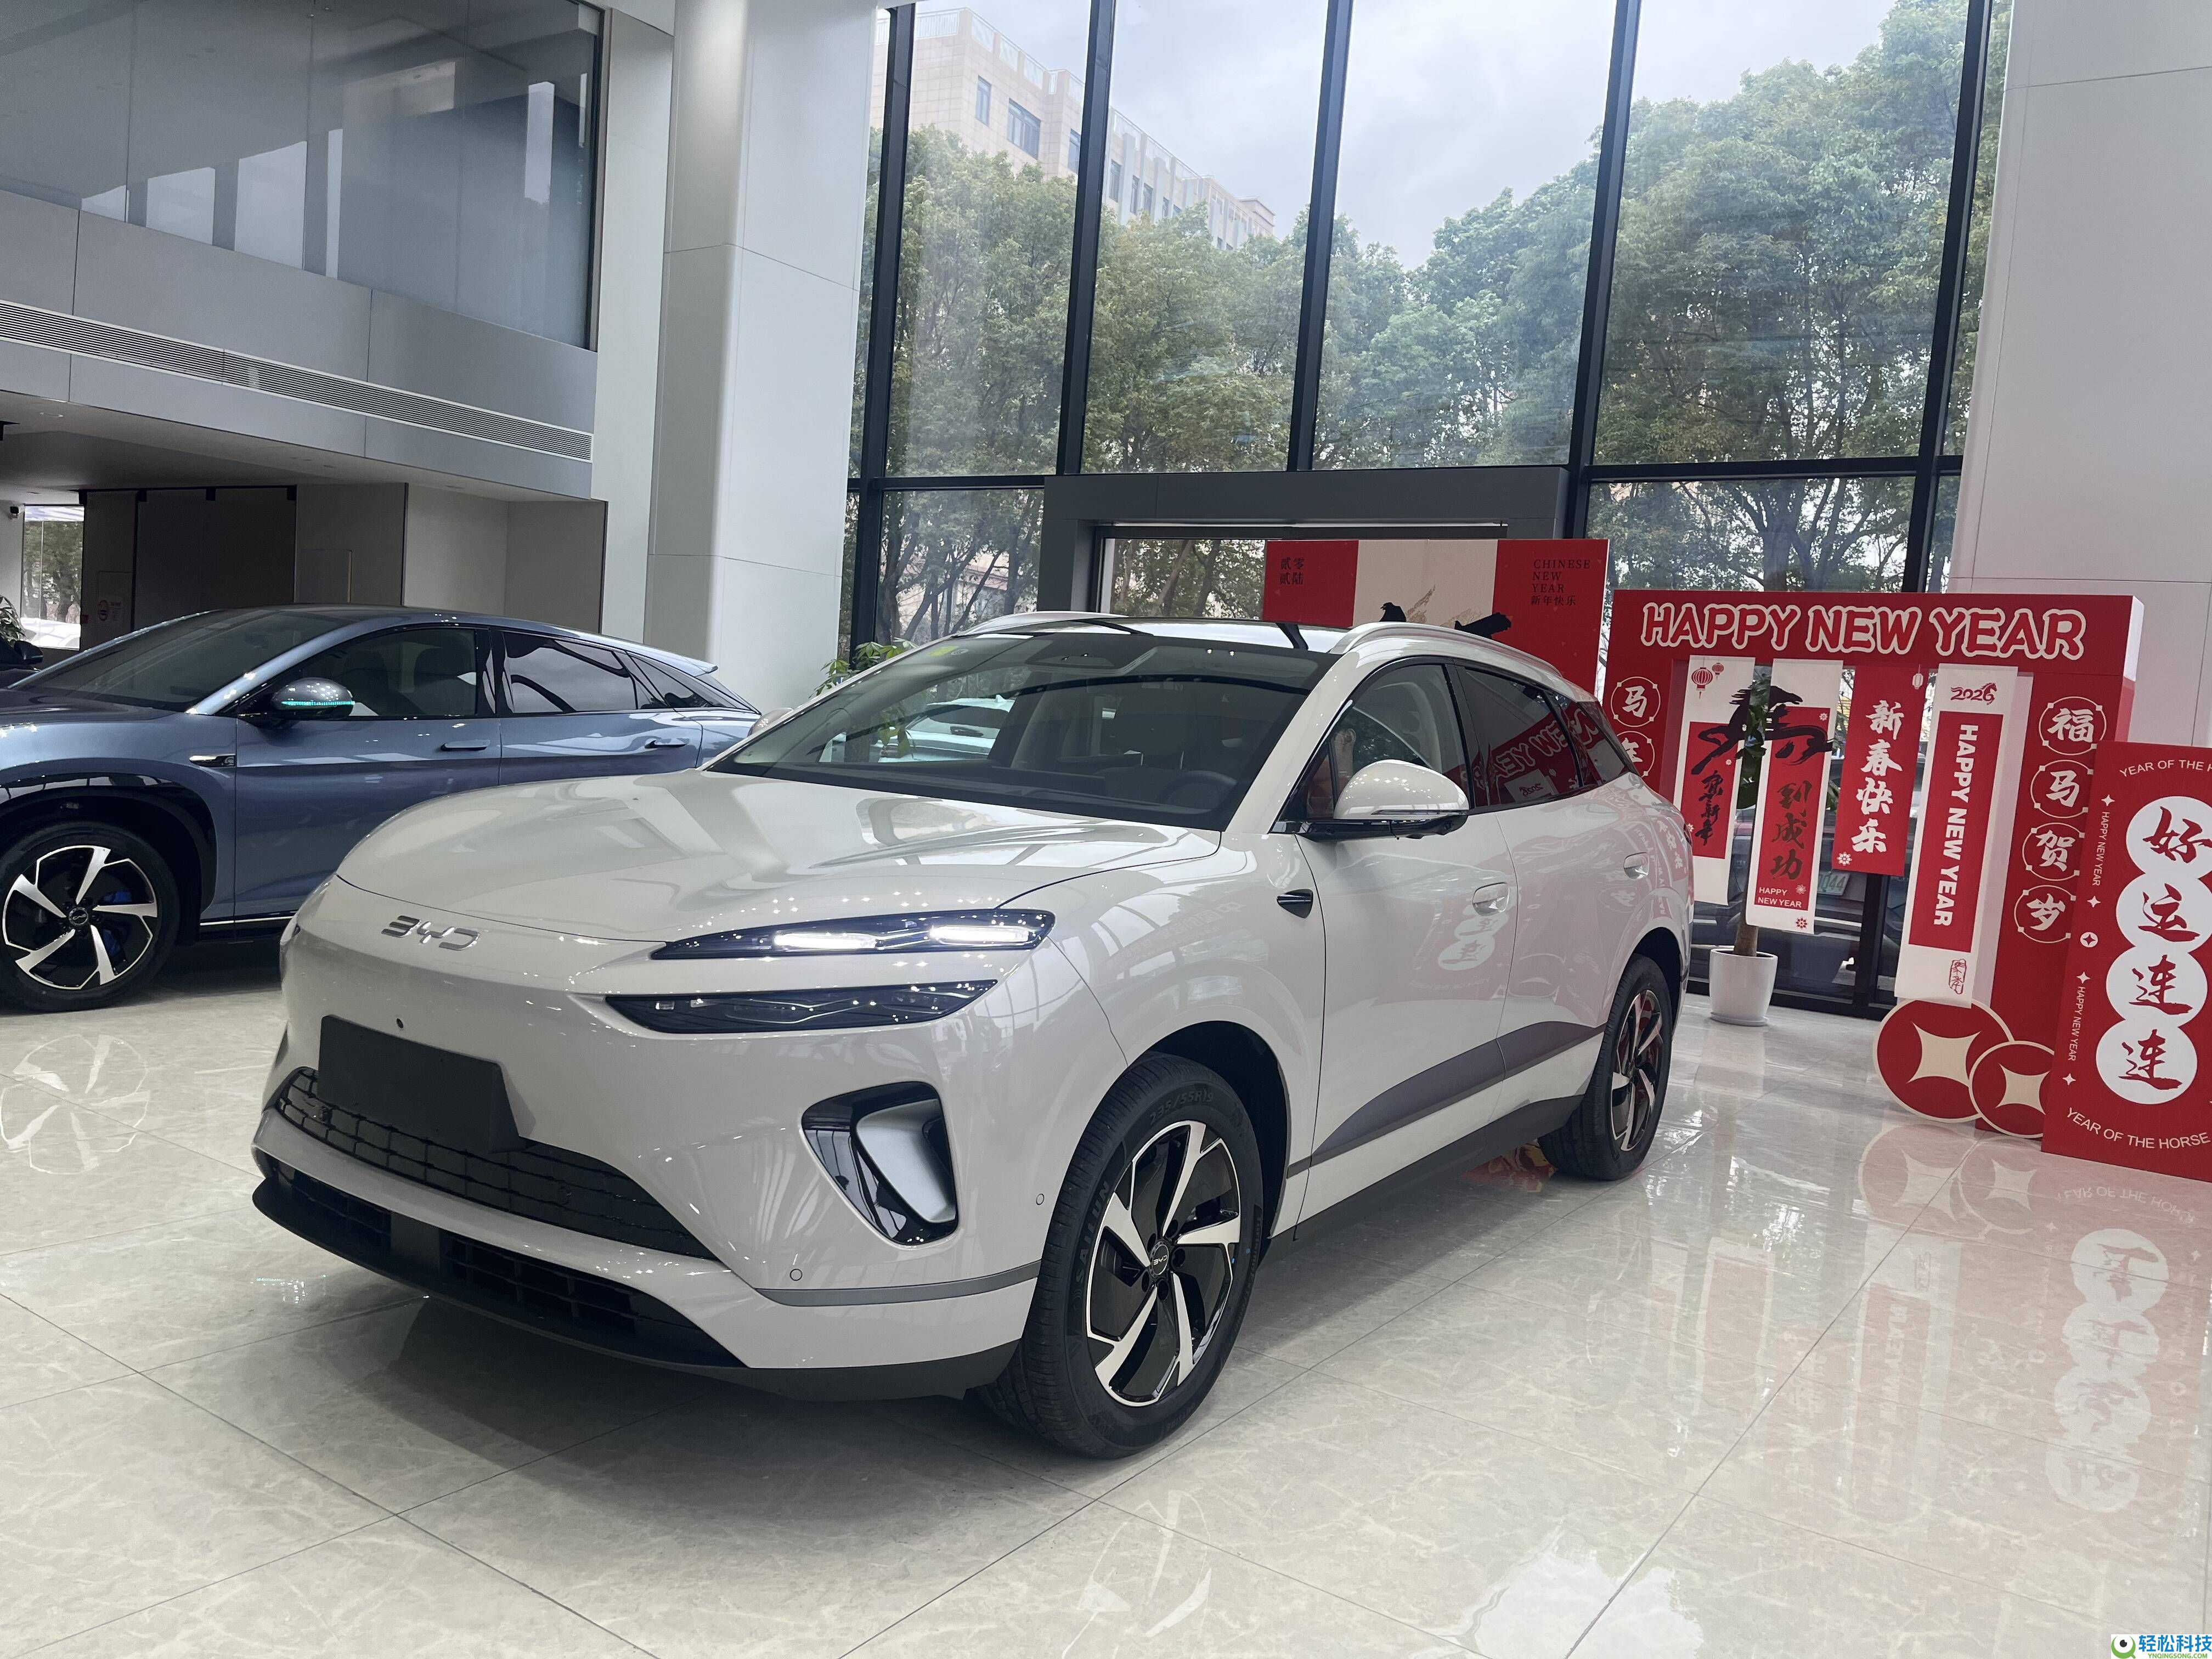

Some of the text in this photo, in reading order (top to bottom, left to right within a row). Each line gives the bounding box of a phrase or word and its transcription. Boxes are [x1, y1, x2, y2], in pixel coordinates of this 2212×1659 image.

[1532, 571, 1562, 580] NEW
[1533, 559, 1590, 569] CHINESE
[1531, 595, 1576, 606] 新年快乐
[1532, 583, 1565, 593] YEAR
[1640, 602, 2086, 660] HAPPY NEW YEAR
[1950, 682, 1997, 706] 2026
[1850, 699, 1904, 854] 新春快乐
[2119, 762, 2154, 777] YEAR
[2158, 759, 2175, 769] OF
[2179, 759, 2205, 771] THE
[1770, 780, 1813, 881] 到成功
[1933, 724, 1979, 927] HAPPY NEW YEAR
[2026, 708, 2095, 931] 福马贺岁
[2092, 811, 2111, 886] HAPPY NEW YEAR
[1758, 897, 1802, 908] NEW YEAR
[1759, 887, 1788, 896] HAPPY
[381, 915, 481, 951] BYD
[2118, 806, 2212, 1091] 好运连连
[2068, 986, 2086, 1062] HAPPY NEW YEAR
[2067, 1107, 2211, 1149] YEAR OF THE HORSE
[1075, 1180, 1110, 1284] SAILUN
[1153, 1254, 1167, 1266] BYD
